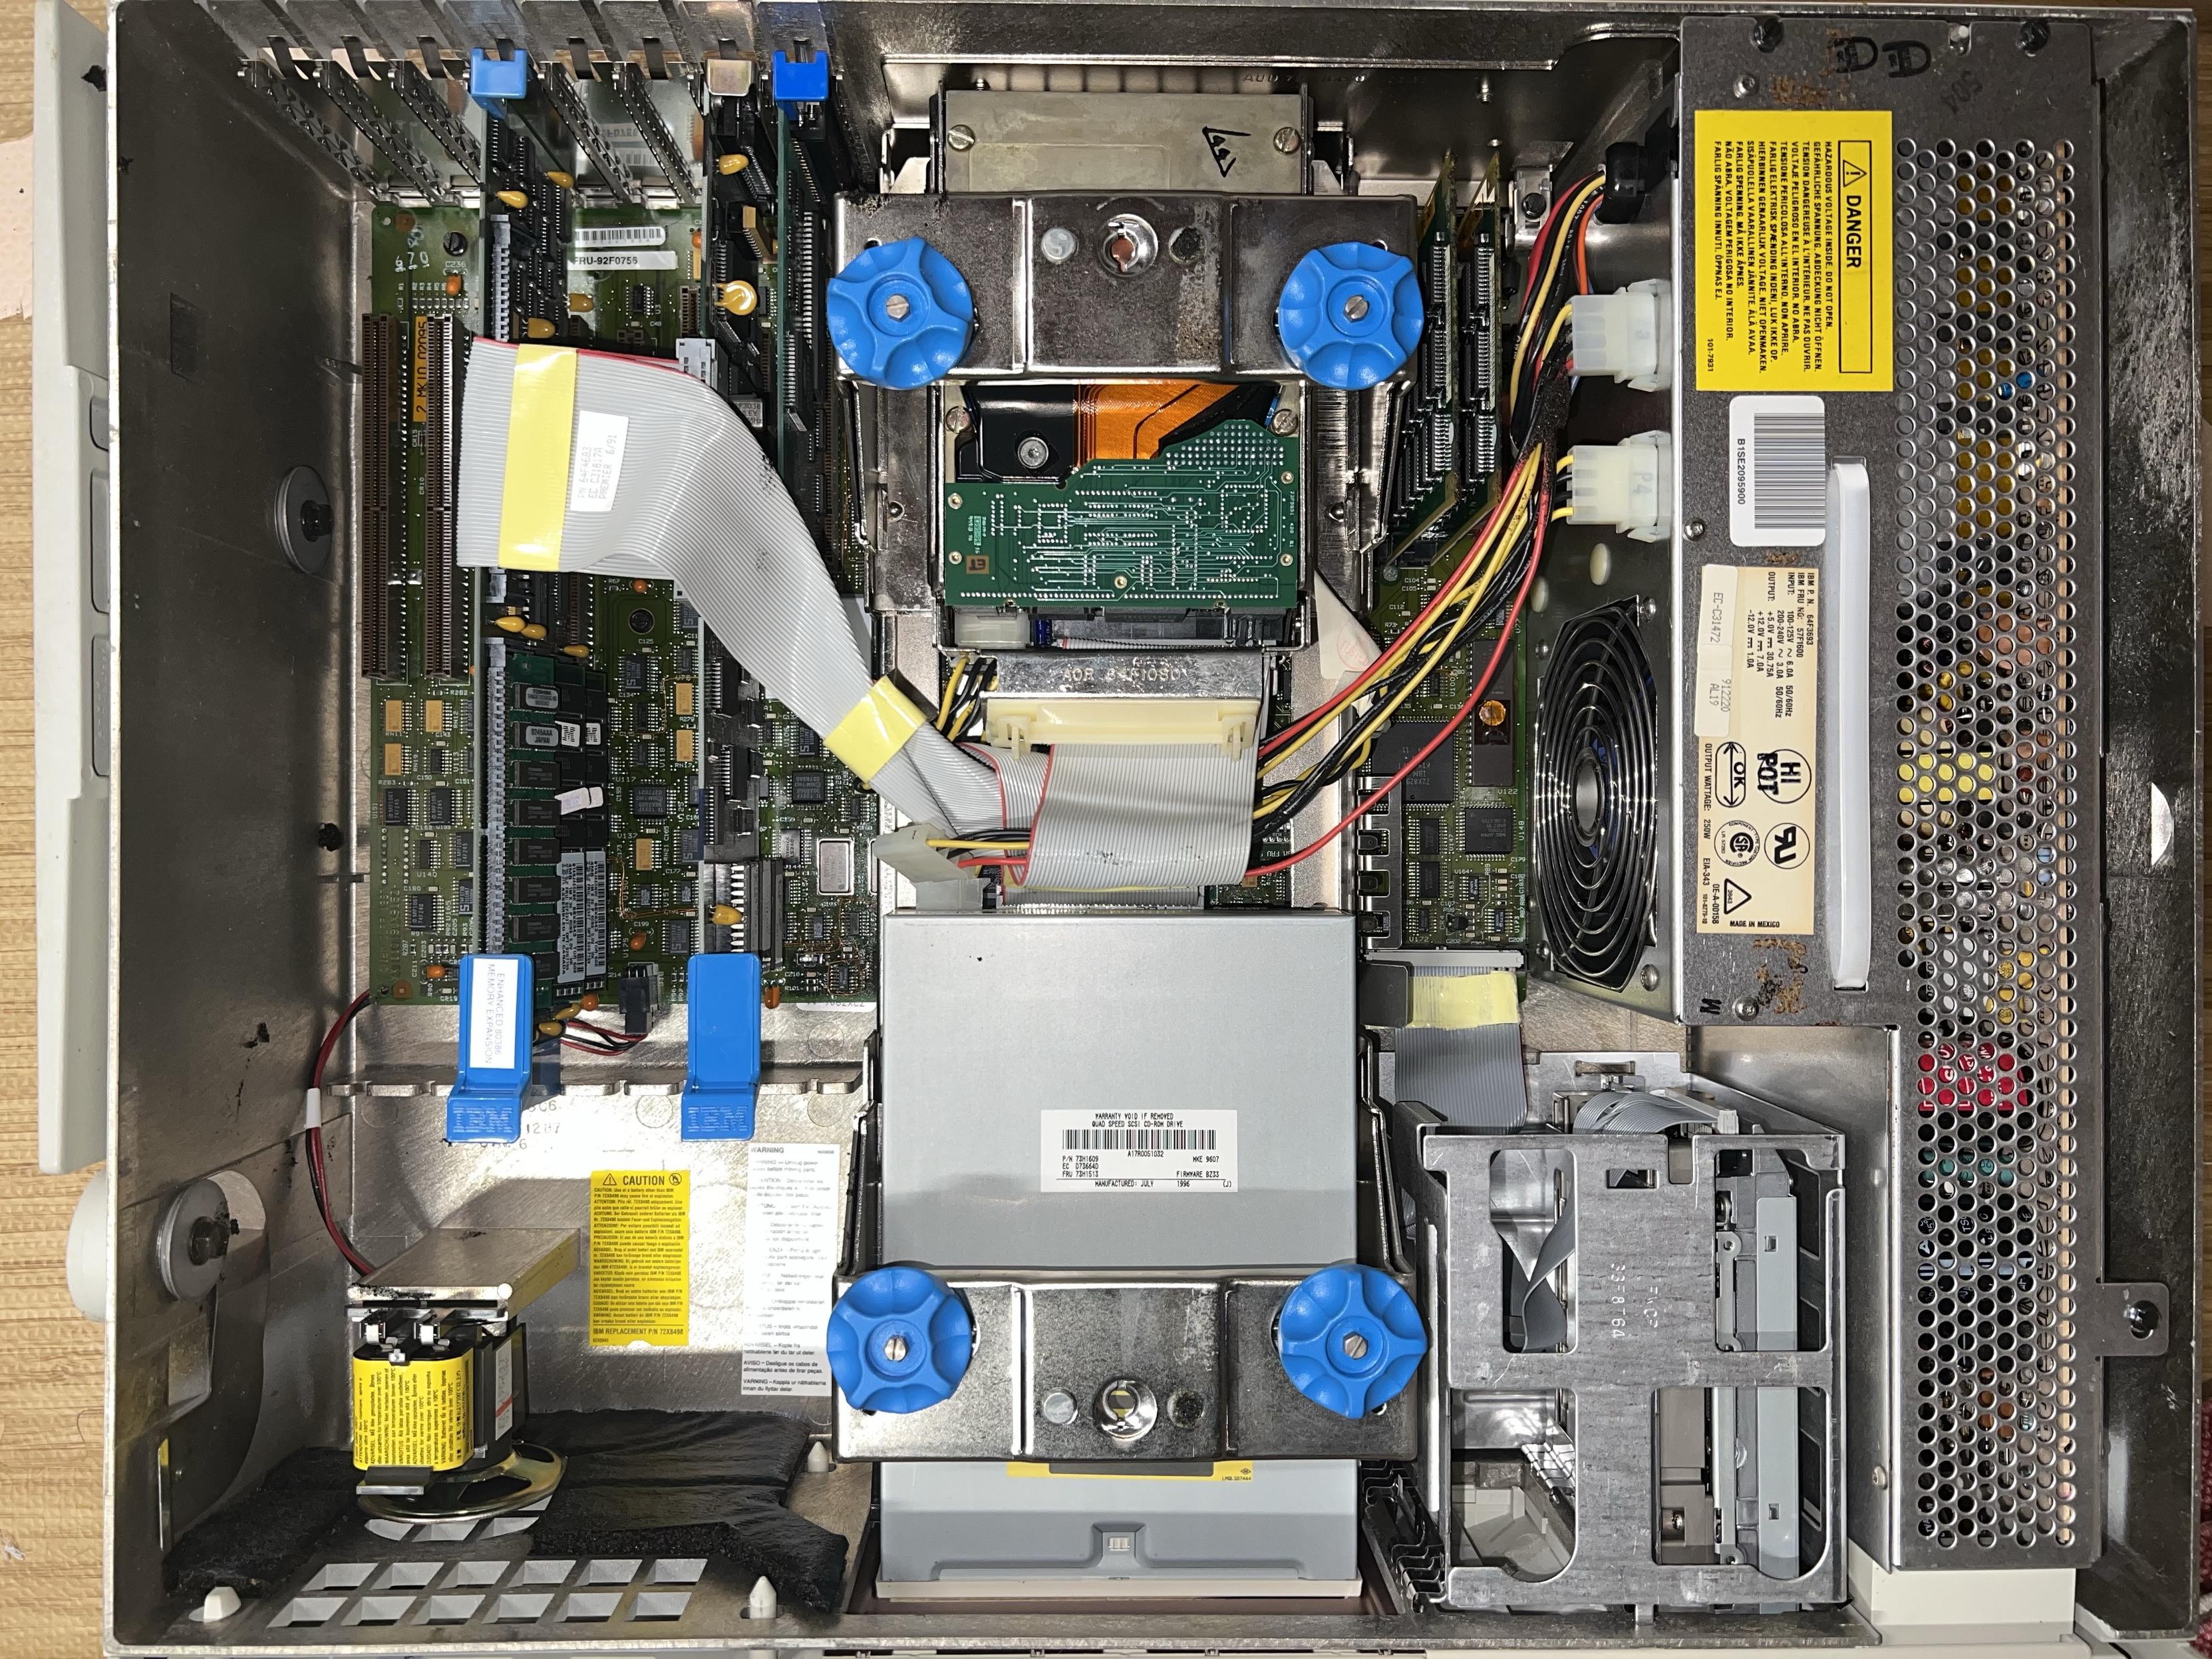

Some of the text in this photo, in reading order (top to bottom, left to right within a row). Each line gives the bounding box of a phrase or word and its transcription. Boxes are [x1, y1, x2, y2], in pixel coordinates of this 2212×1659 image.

[1814, 142, 1823, 200] GEFÄHRLICHE
[1715, 175, 1724, 217] SPÄNNING
[1737, 222, 1746, 234] MÅ
[1792, 231, 1799, 241] EN
[1847, 196, 1861, 267] DANGER
[1792, 245, 1799, 254] EL
[1715, 255, 1724, 285] ÖPPNAS
[1737, 259, 1746, 287] ÅPNES.
[1826, 271, 1833, 282] DO
[1726, 283, 1733, 294] NO
[1748, 269, 1757, 307] JÄNNITE.
[1769, 273, 1778, 304] INDENI,
[1793, 303, 1800, 314] NO
[1804, 305, 1810, 316] NE
[1815, 336, 1823, 371] ÖFFNEN.
[1710, 683, 1720, 705] AL19
[1721, 679, 1731, 712] 912220
[1734, 762, 1744, 788] OK
[1758, 753, 1778, 796] POT
[1780, 762, 1801, 784] HI
[496, 973, 505, 1026] ENHANCED
[485, 964, 496, 1063] MEMORY EXPANSION
[453, 1107, 513, 1132] IBM
[689, 1107, 748, 1131] IBM
[623, 1175, 664, 1185] CAUTION
